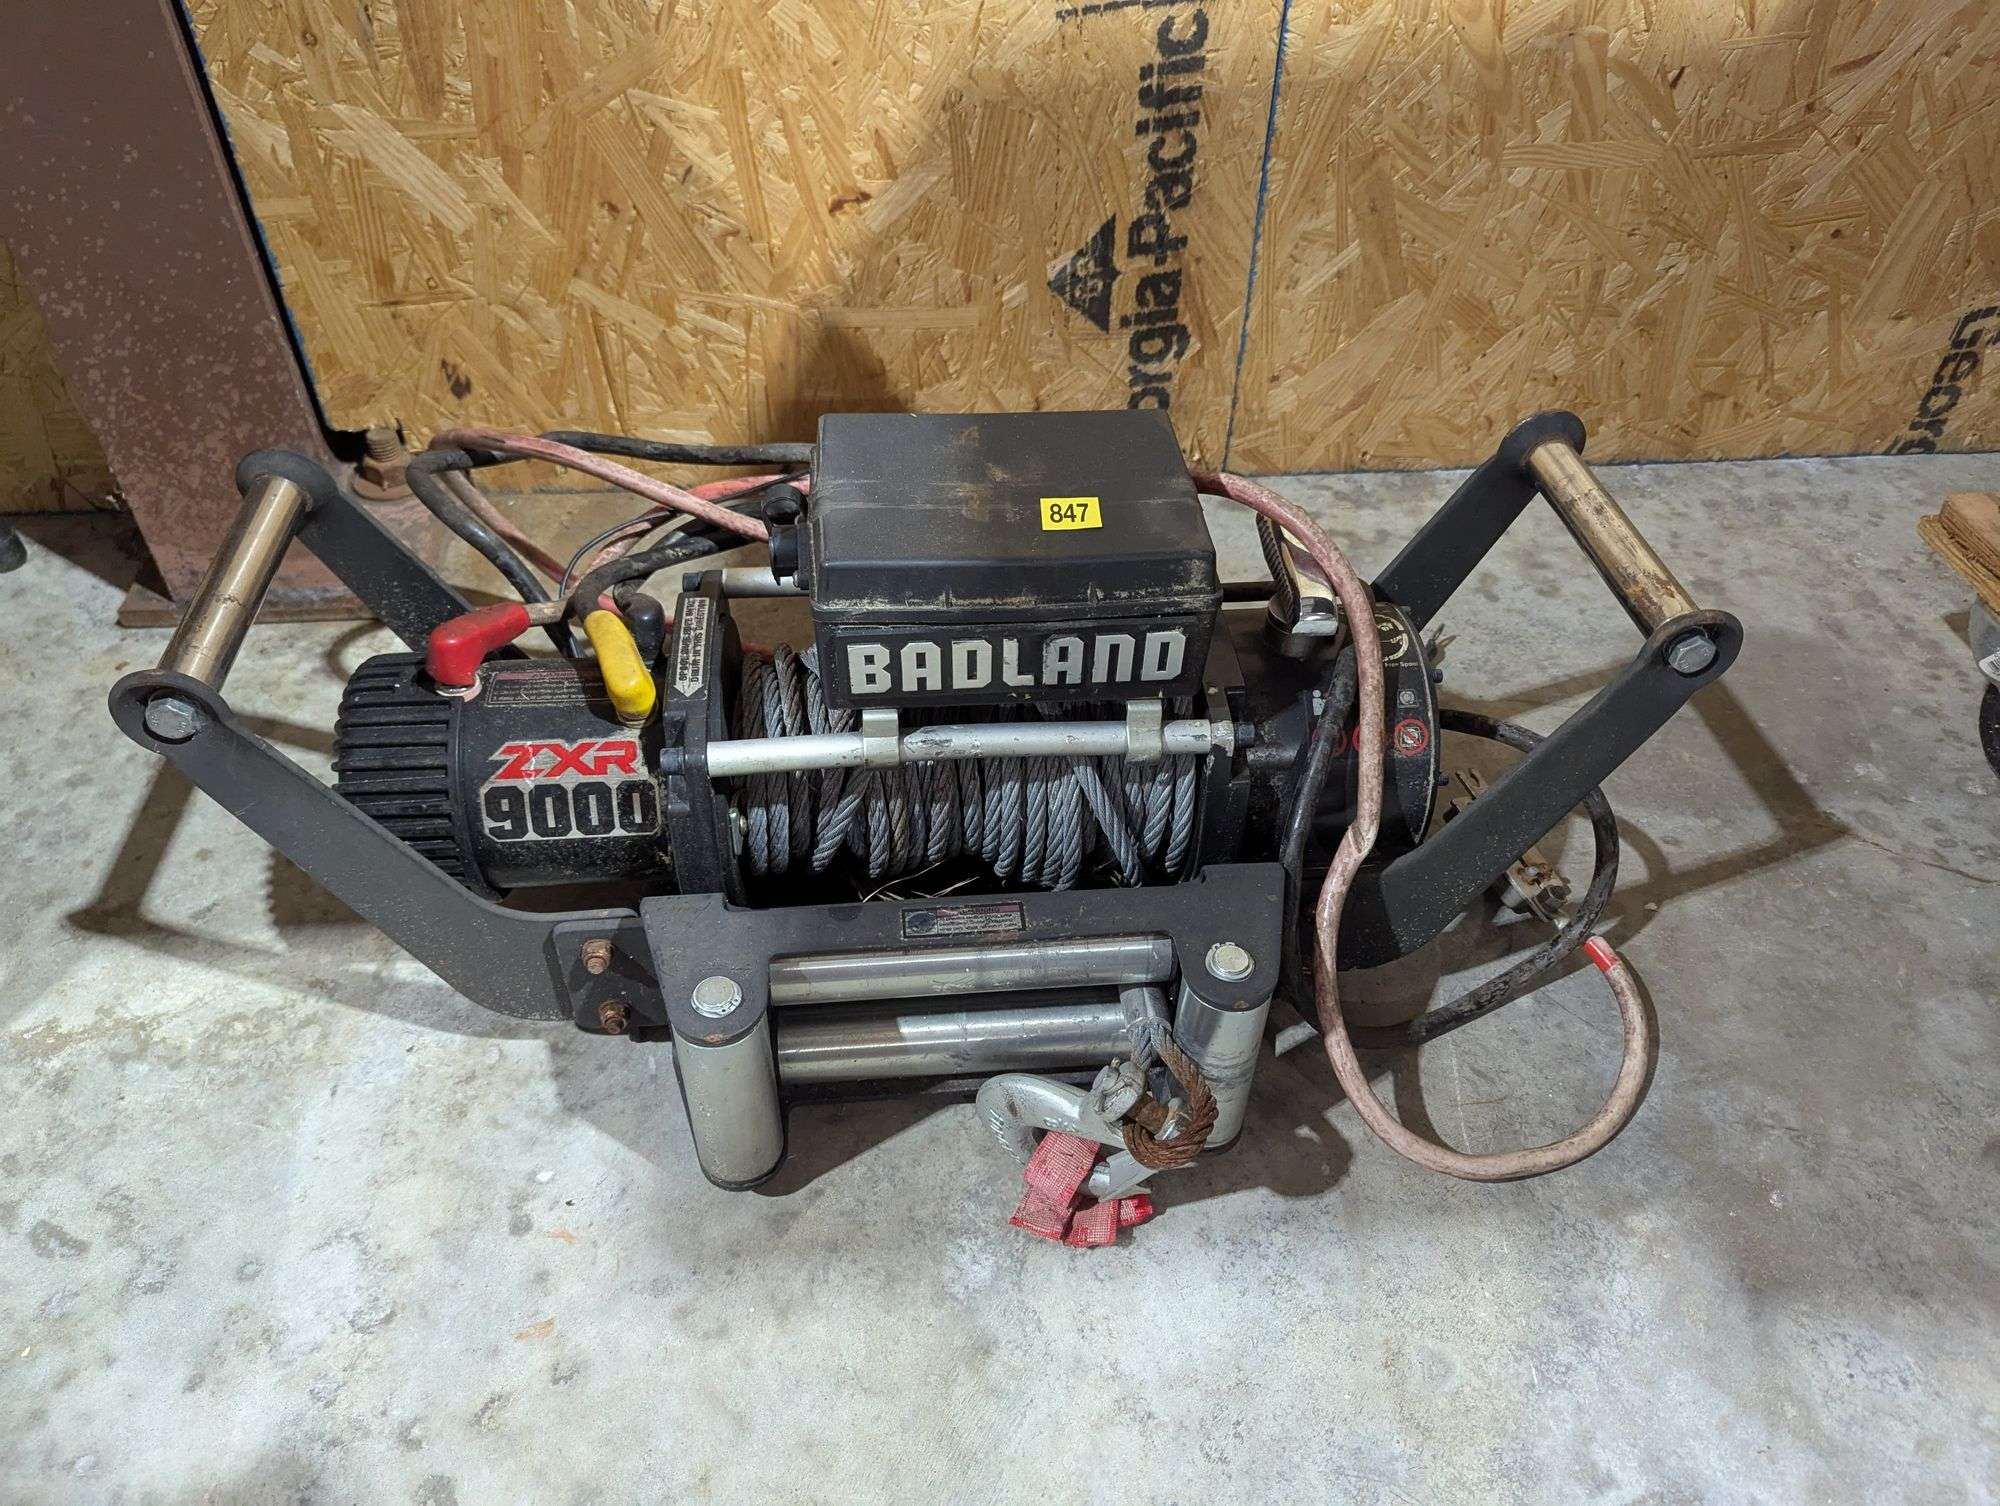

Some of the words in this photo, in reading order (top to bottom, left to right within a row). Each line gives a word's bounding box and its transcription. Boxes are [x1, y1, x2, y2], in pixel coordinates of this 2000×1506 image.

[1050, 503, 1089, 523] 847
[847, 631, 1187, 695] BADLAND
[491, 739, 640, 780] ZXR
[482, 779, 660, 841] 9000
